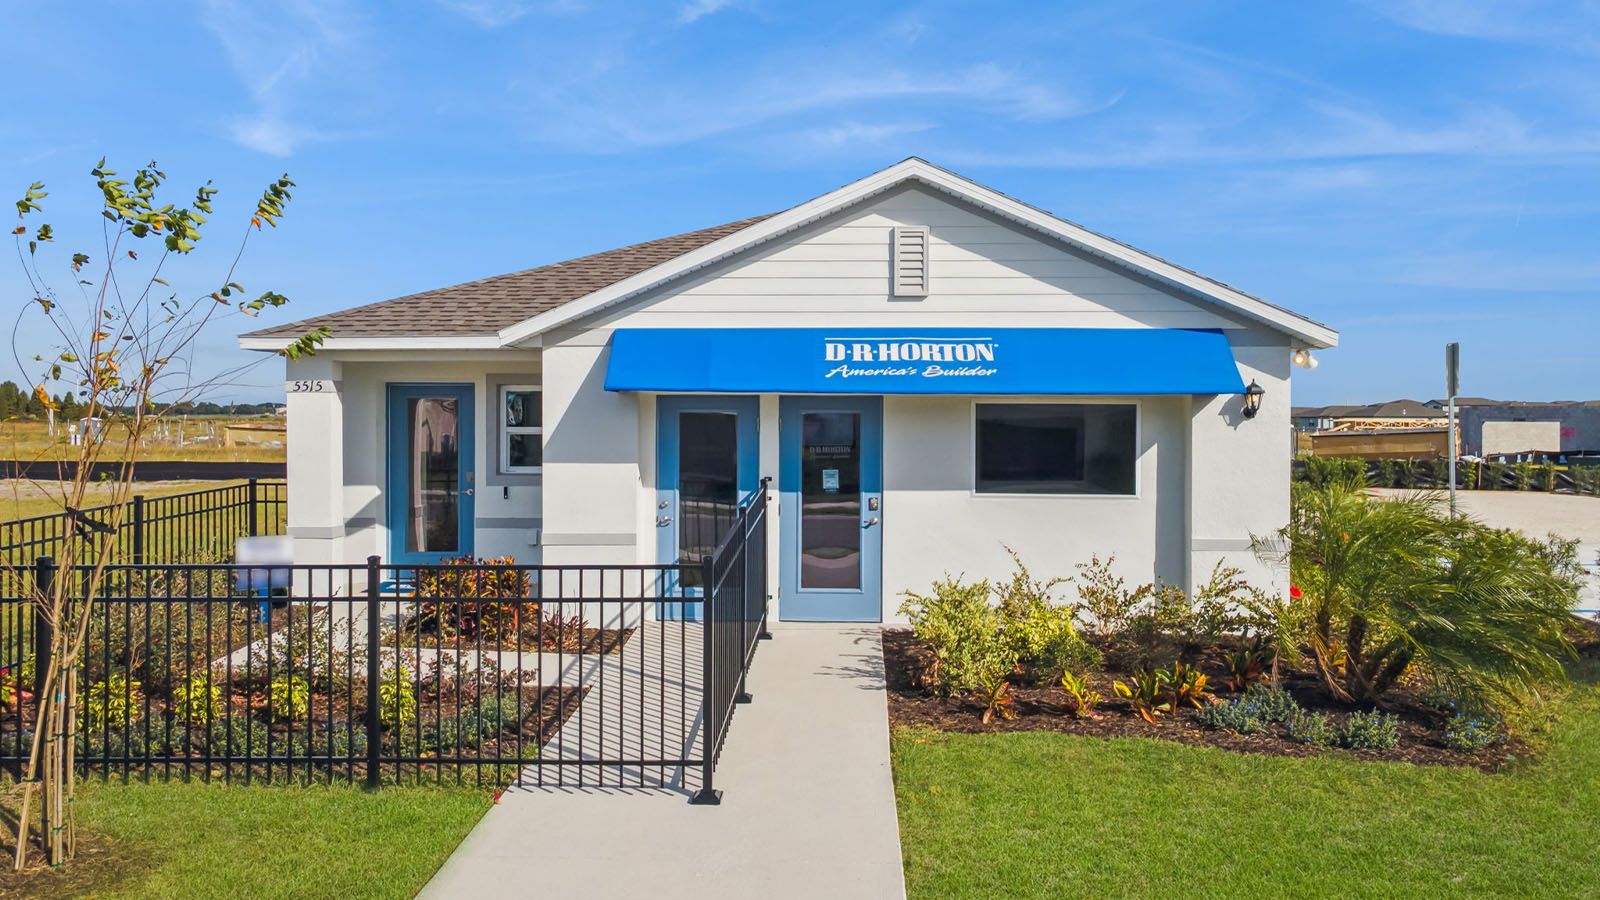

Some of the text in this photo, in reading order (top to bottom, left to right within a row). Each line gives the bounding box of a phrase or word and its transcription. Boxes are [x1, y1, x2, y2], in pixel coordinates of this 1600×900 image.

[825, 364, 997, 378] America's Builder
[292, 380, 323, 392] 5515
